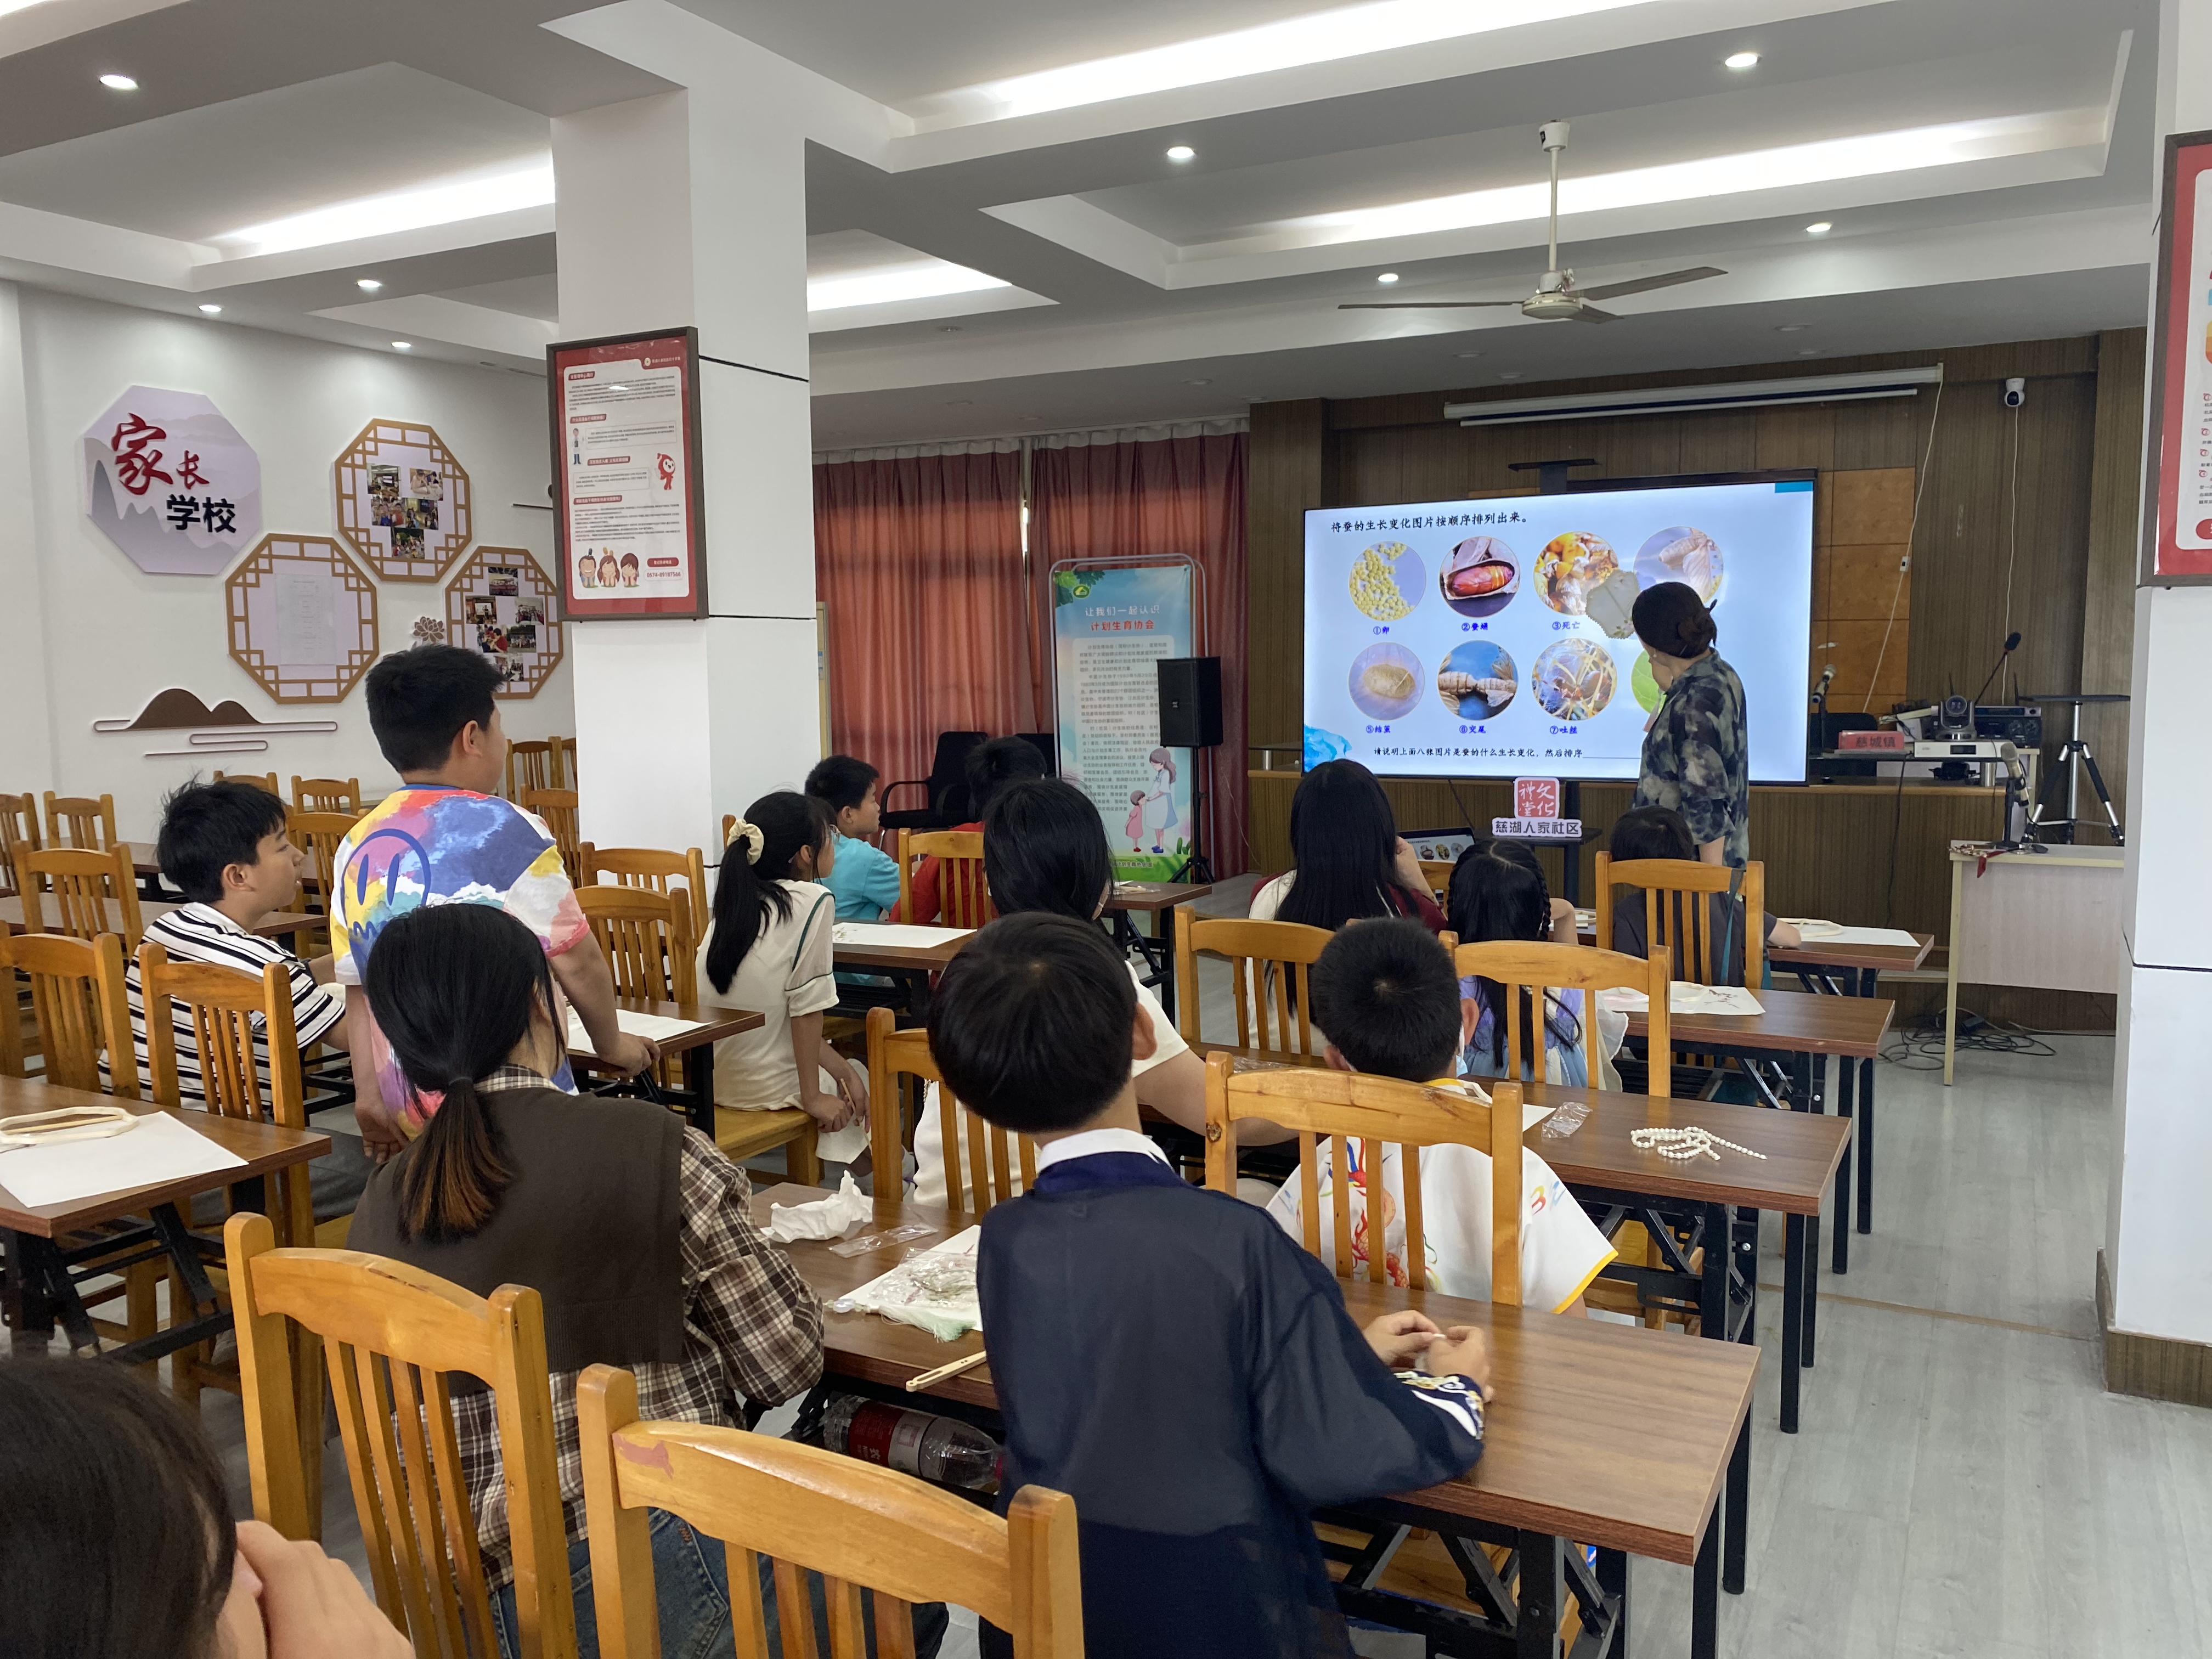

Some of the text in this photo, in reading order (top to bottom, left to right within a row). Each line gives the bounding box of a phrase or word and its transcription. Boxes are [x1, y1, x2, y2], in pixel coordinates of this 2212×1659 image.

[111, 413, 210, 495] 家长
[166, 494, 236, 533] 学校
[1331, 511, 1527, 533] 将蚕的生长变化图片按顺序排列出来。
[1085, 605, 1160, 617] 让我们一起认识
[1091, 619, 1154, 631] 计划生育协会
[1496, 821, 1579, 834] 慈湖人家社区
